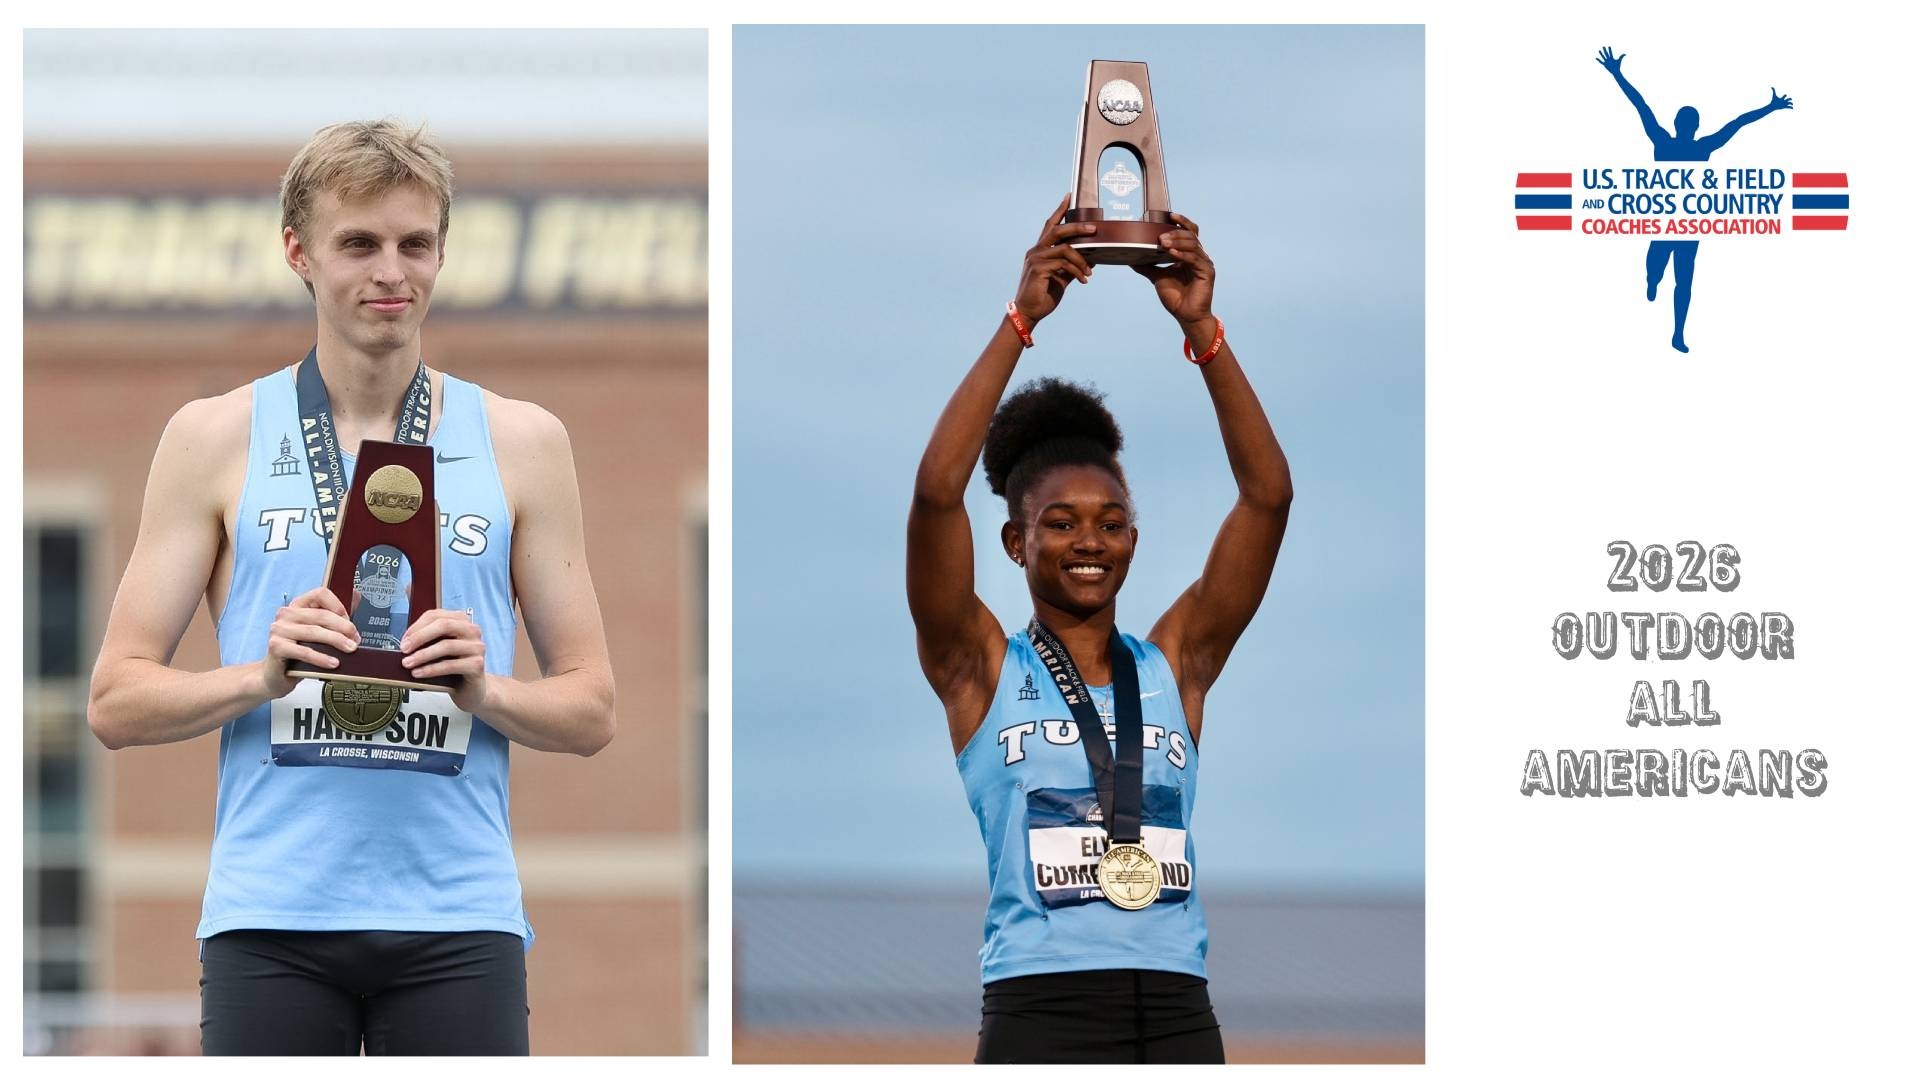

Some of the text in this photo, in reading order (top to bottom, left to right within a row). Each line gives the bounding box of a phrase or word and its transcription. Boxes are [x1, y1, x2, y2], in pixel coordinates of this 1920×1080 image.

[1102, 99, 1142, 113] NCAA
[319, 412, 331, 439] NCAA
[324, 438, 342, 476] DIVISION
[367, 491, 420, 511] NCAA
[369, 553, 400, 567] 2026
[368, 616, 390, 626] 2026
[293, 708, 449, 749] HASON
[319, 747, 420, 763] LA CROSSE, WISCONSIN
[1080, 889, 1090, 899] LA
